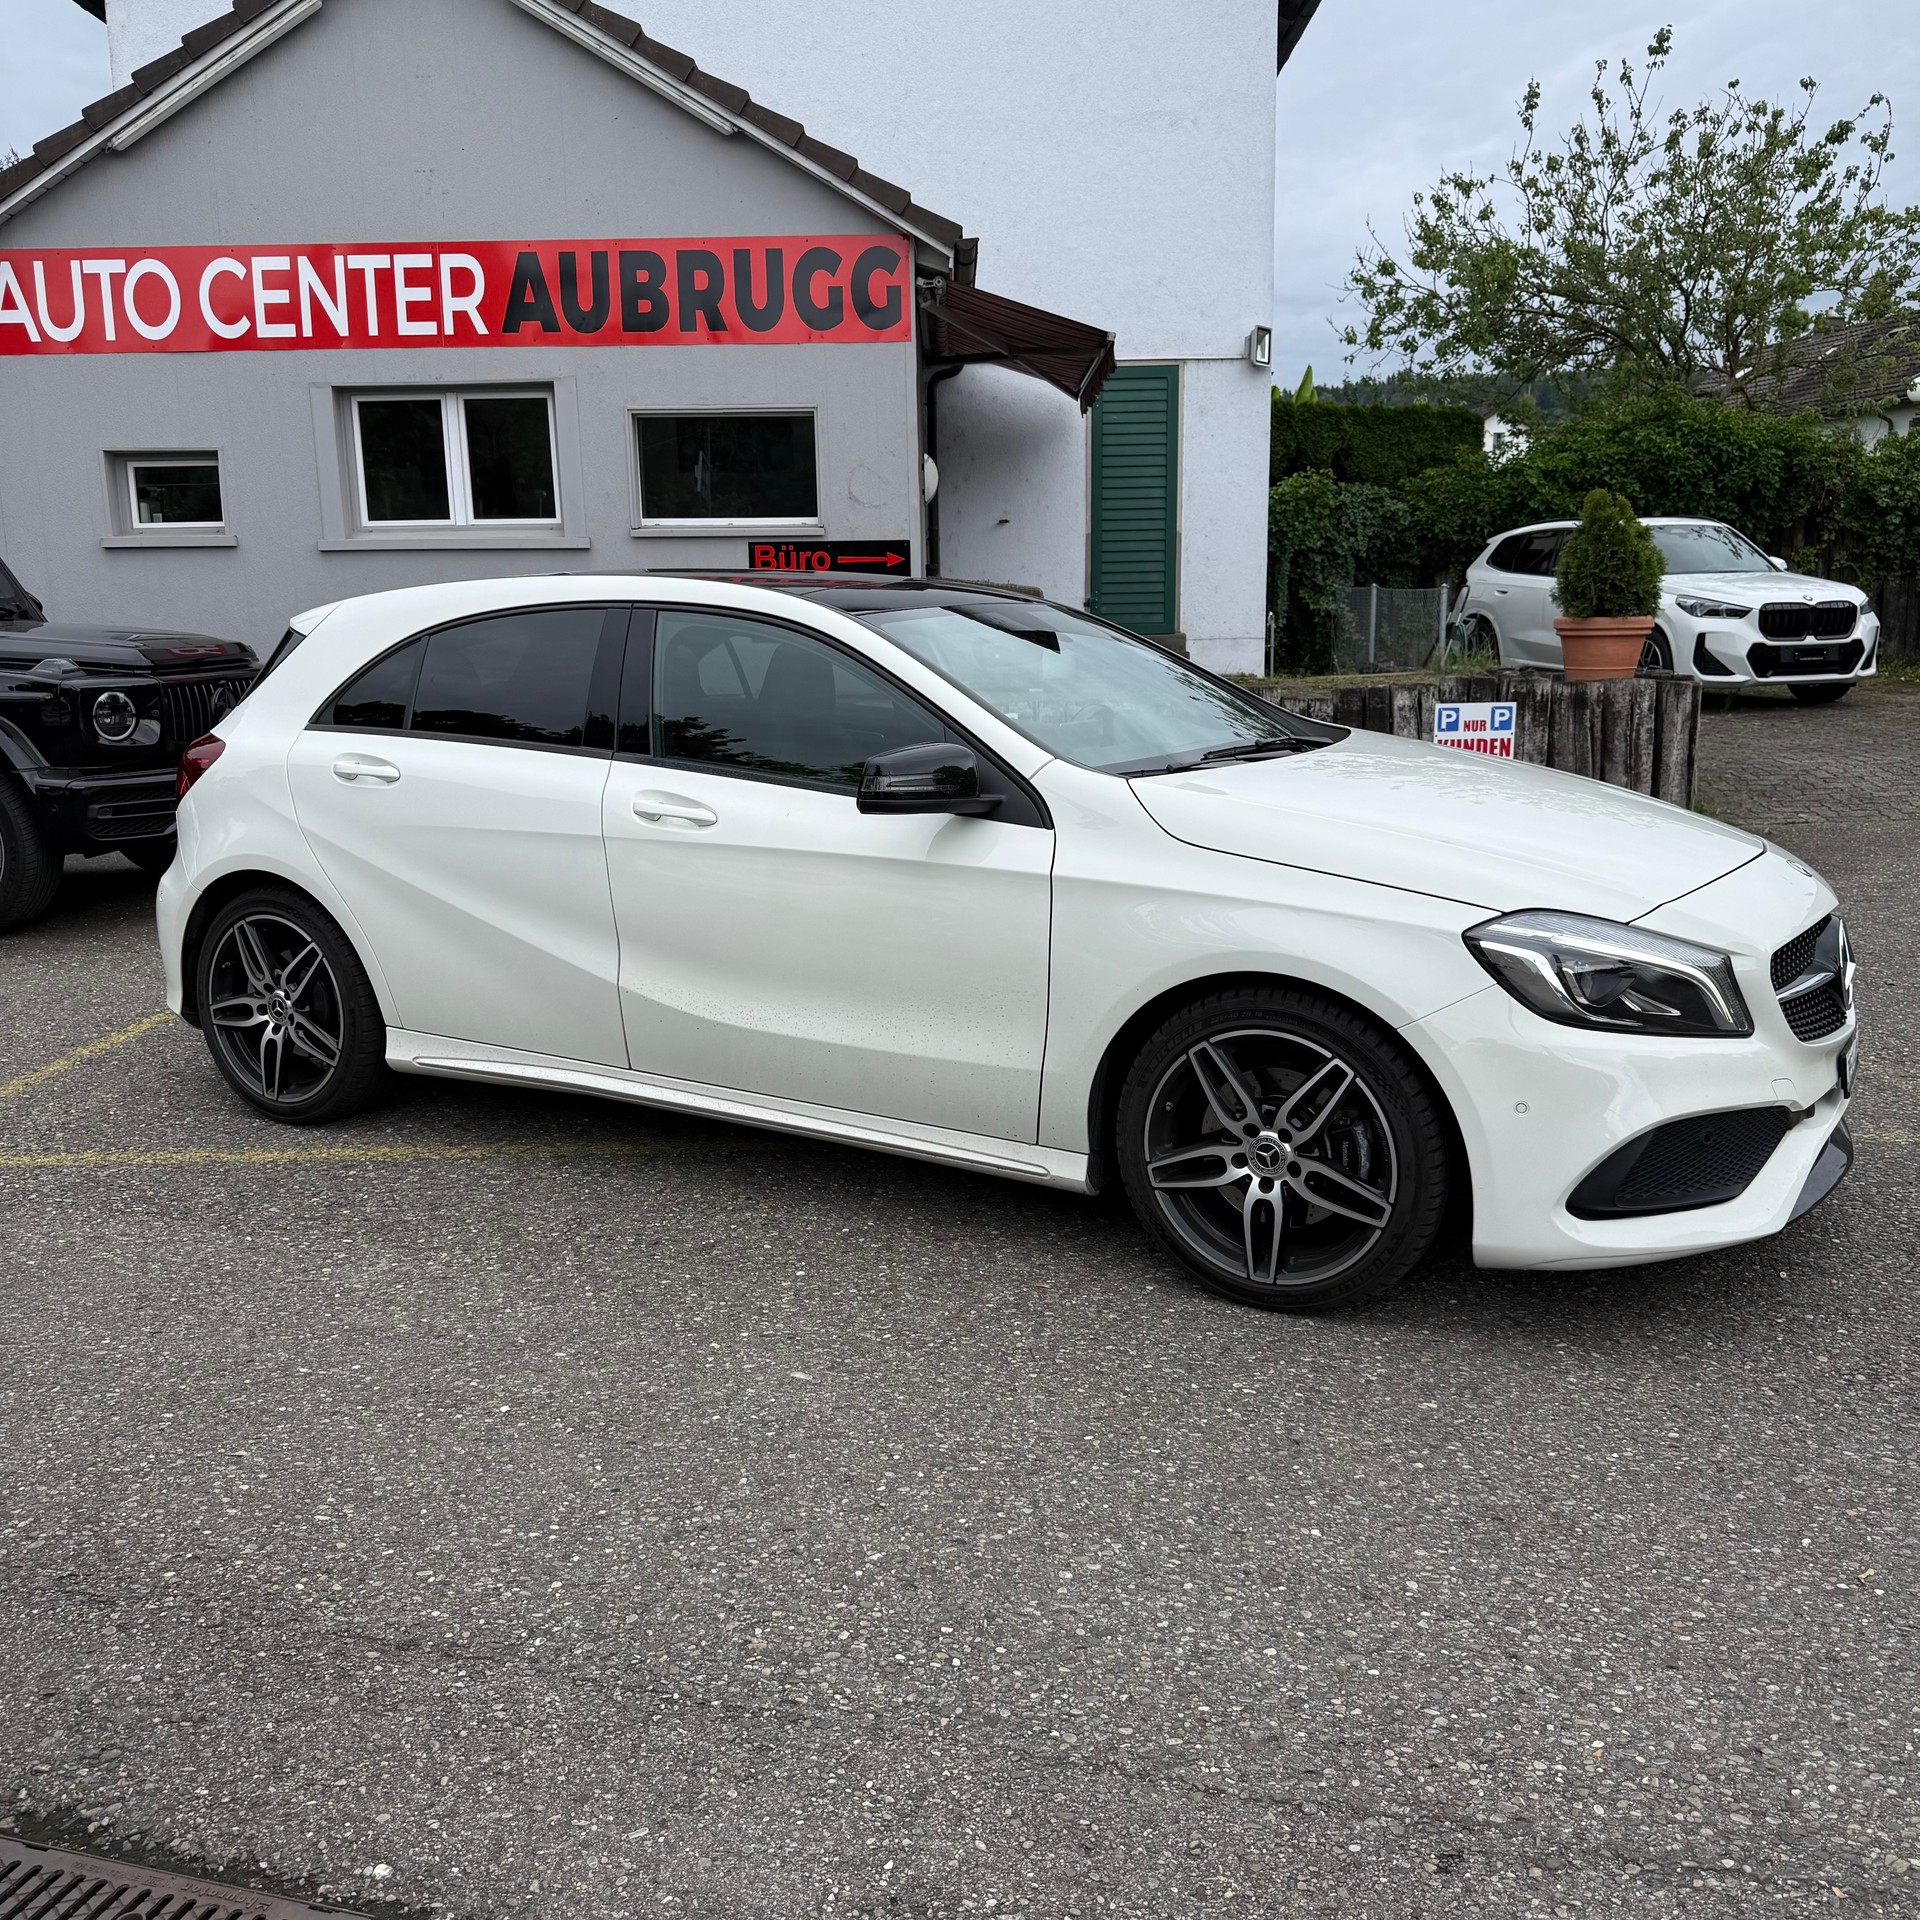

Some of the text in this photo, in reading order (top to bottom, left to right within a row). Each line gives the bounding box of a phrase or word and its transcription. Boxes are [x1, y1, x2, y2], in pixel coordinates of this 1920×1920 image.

[0, 245, 902, 342] AUTO CENTER AUBRUGG
[754, 544, 831, 571] Büro
[1463, 719, 1487, 732] NUR
